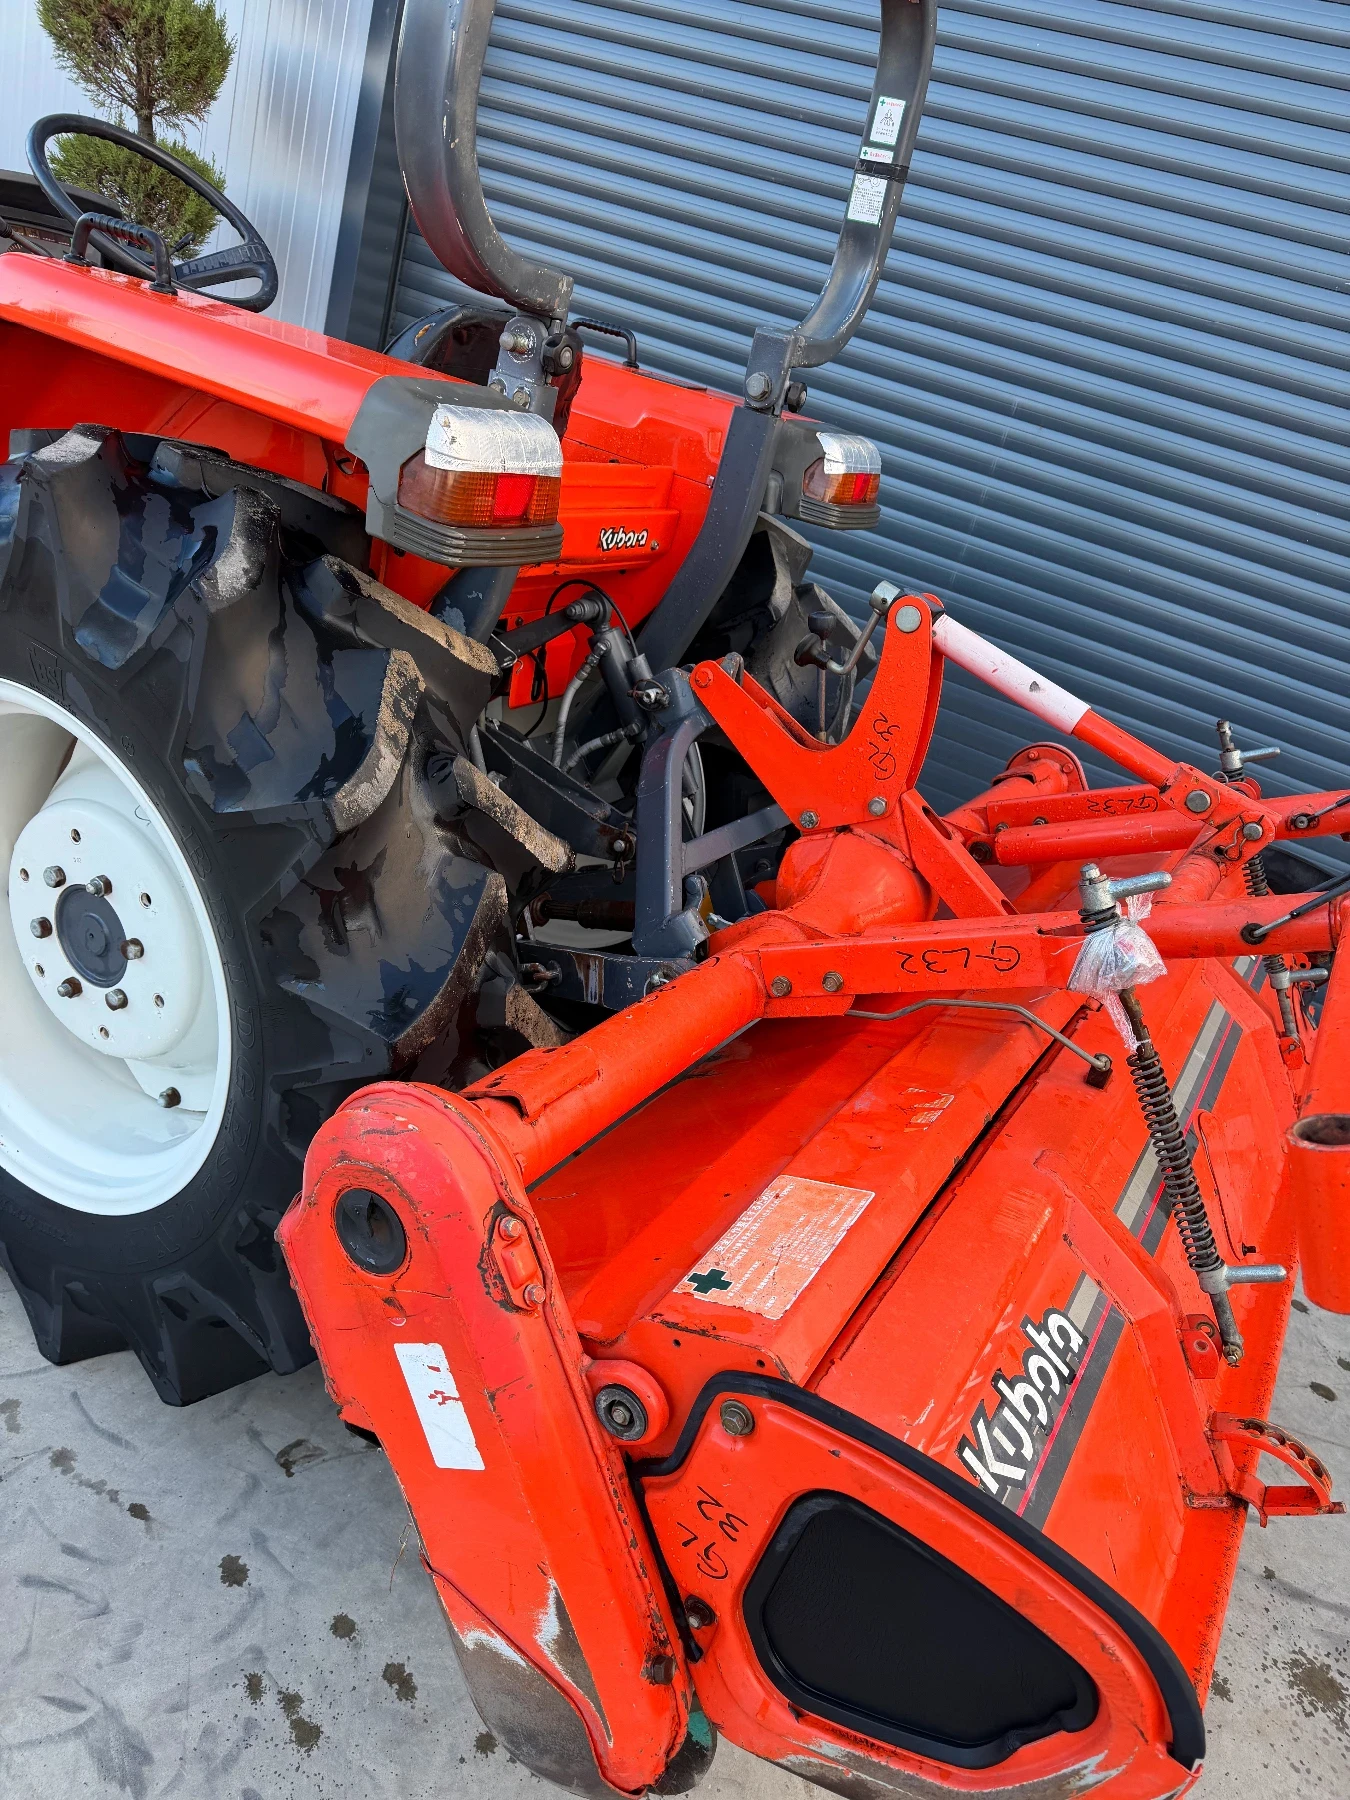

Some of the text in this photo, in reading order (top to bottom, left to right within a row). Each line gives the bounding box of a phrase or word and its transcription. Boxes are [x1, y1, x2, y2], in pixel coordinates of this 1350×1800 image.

[600, 526, 648, 551] Kubota
[123, 822, 256, 1266] BRIDGESTONE
[960, 1312, 1084, 1495] Kubota
